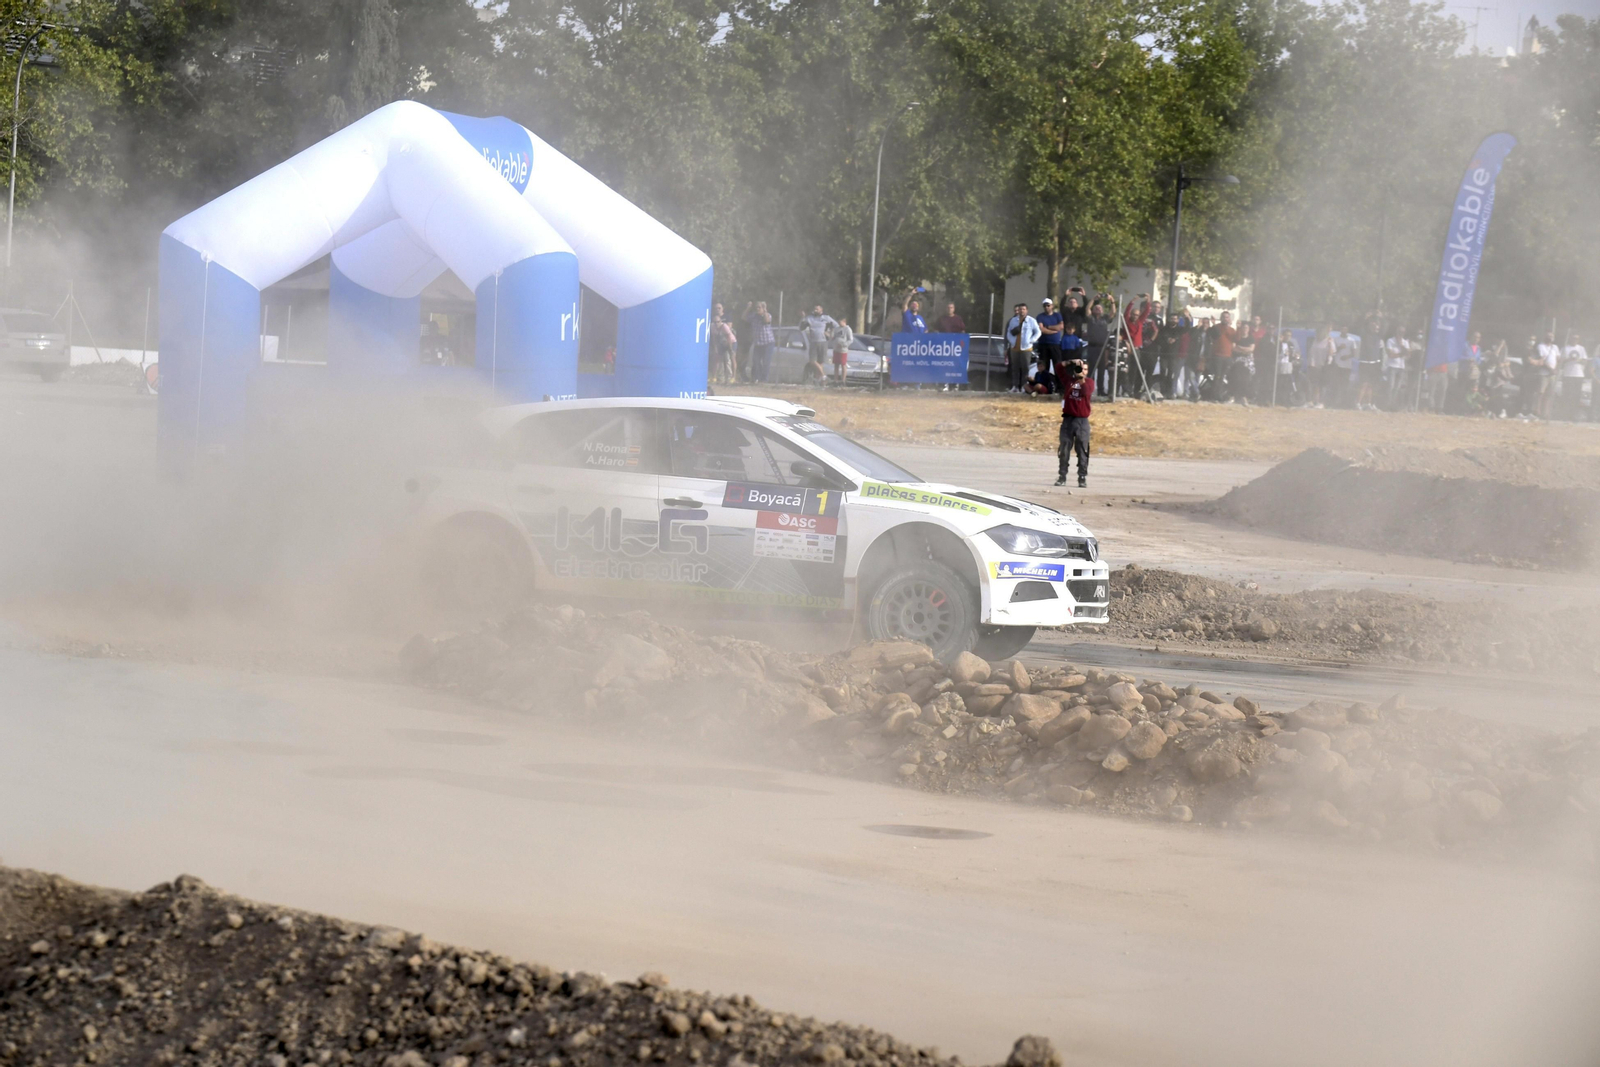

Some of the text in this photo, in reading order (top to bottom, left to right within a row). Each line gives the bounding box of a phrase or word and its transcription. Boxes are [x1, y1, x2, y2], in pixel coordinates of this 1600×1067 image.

[1437, 168, 1490, 331] radiokable
[561, 302, 579, 341] rk
[897, 340, 962, 357] radiokable
[583, 442, 628, 454] N.Roma
[585, 455, 625, 467] A.Haro
[748, 489, 801, 506] Boyacá
[816, 491, 828, 515] 1
[789, 517, 817, 529] ASC
[1012, 567, 1058, 577] MICHELIN
